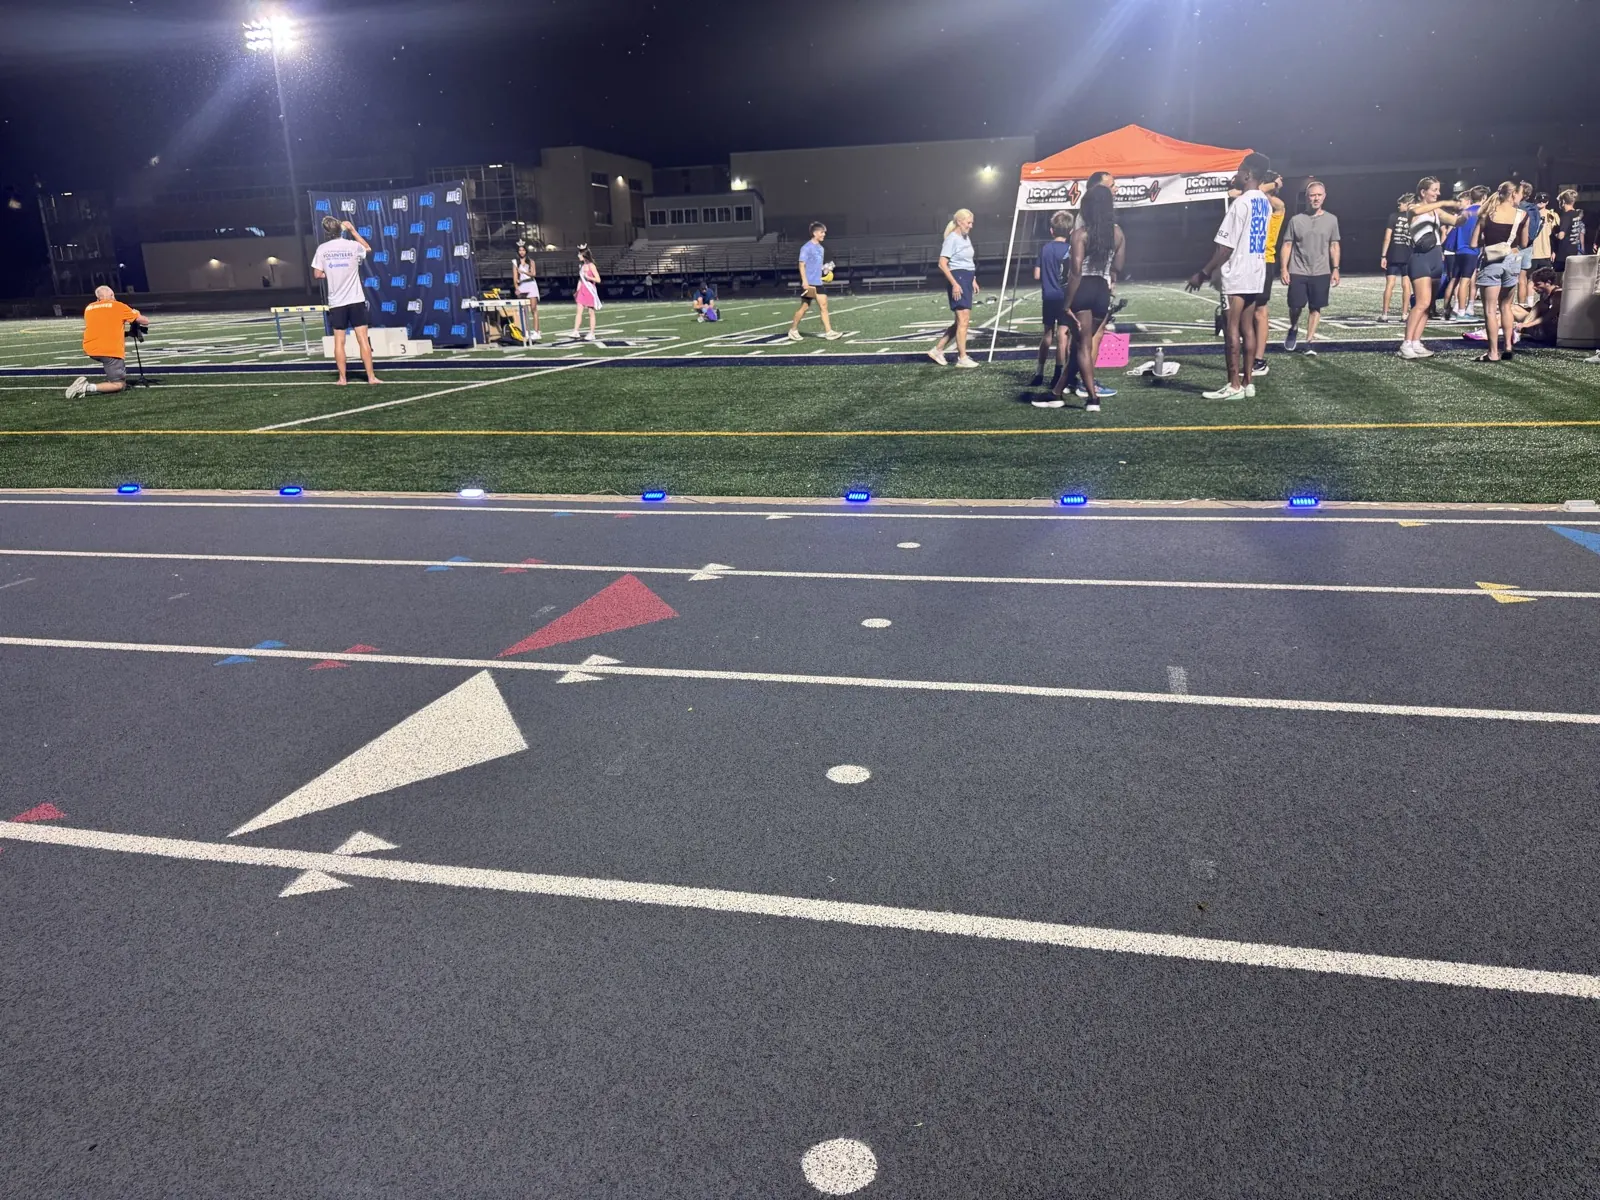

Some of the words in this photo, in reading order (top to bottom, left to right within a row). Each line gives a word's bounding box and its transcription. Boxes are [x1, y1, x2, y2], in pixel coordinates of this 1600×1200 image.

[1187, 176, 1228, 188] ICONIC
[1116, 186, 1146, 196] ONIC
[400, 343, 407, 354] 3
